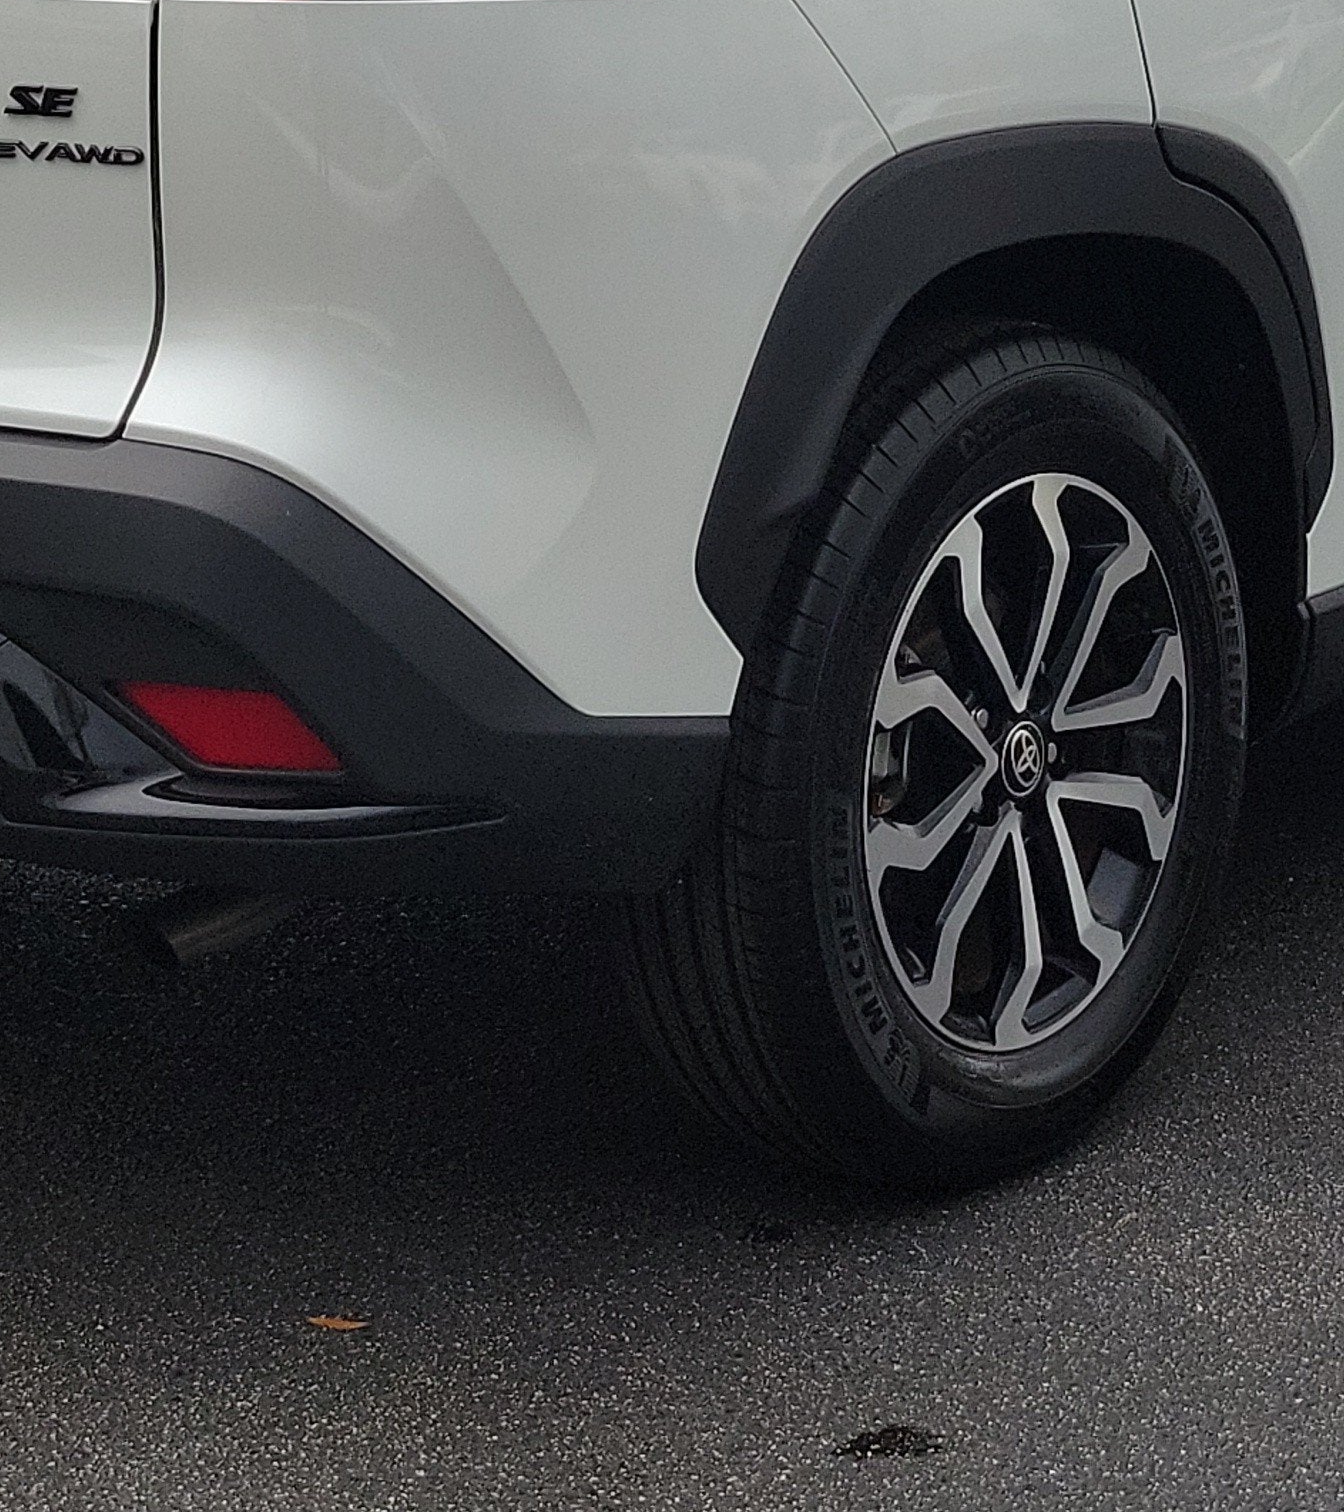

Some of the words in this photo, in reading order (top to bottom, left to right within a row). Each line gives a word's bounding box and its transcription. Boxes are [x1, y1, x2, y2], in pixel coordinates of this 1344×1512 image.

[4, 85, 78, 117] SE
[1197, 516, 1247, 738] MICHELIN
[826, 800, 888, 1034] MICHELIN
